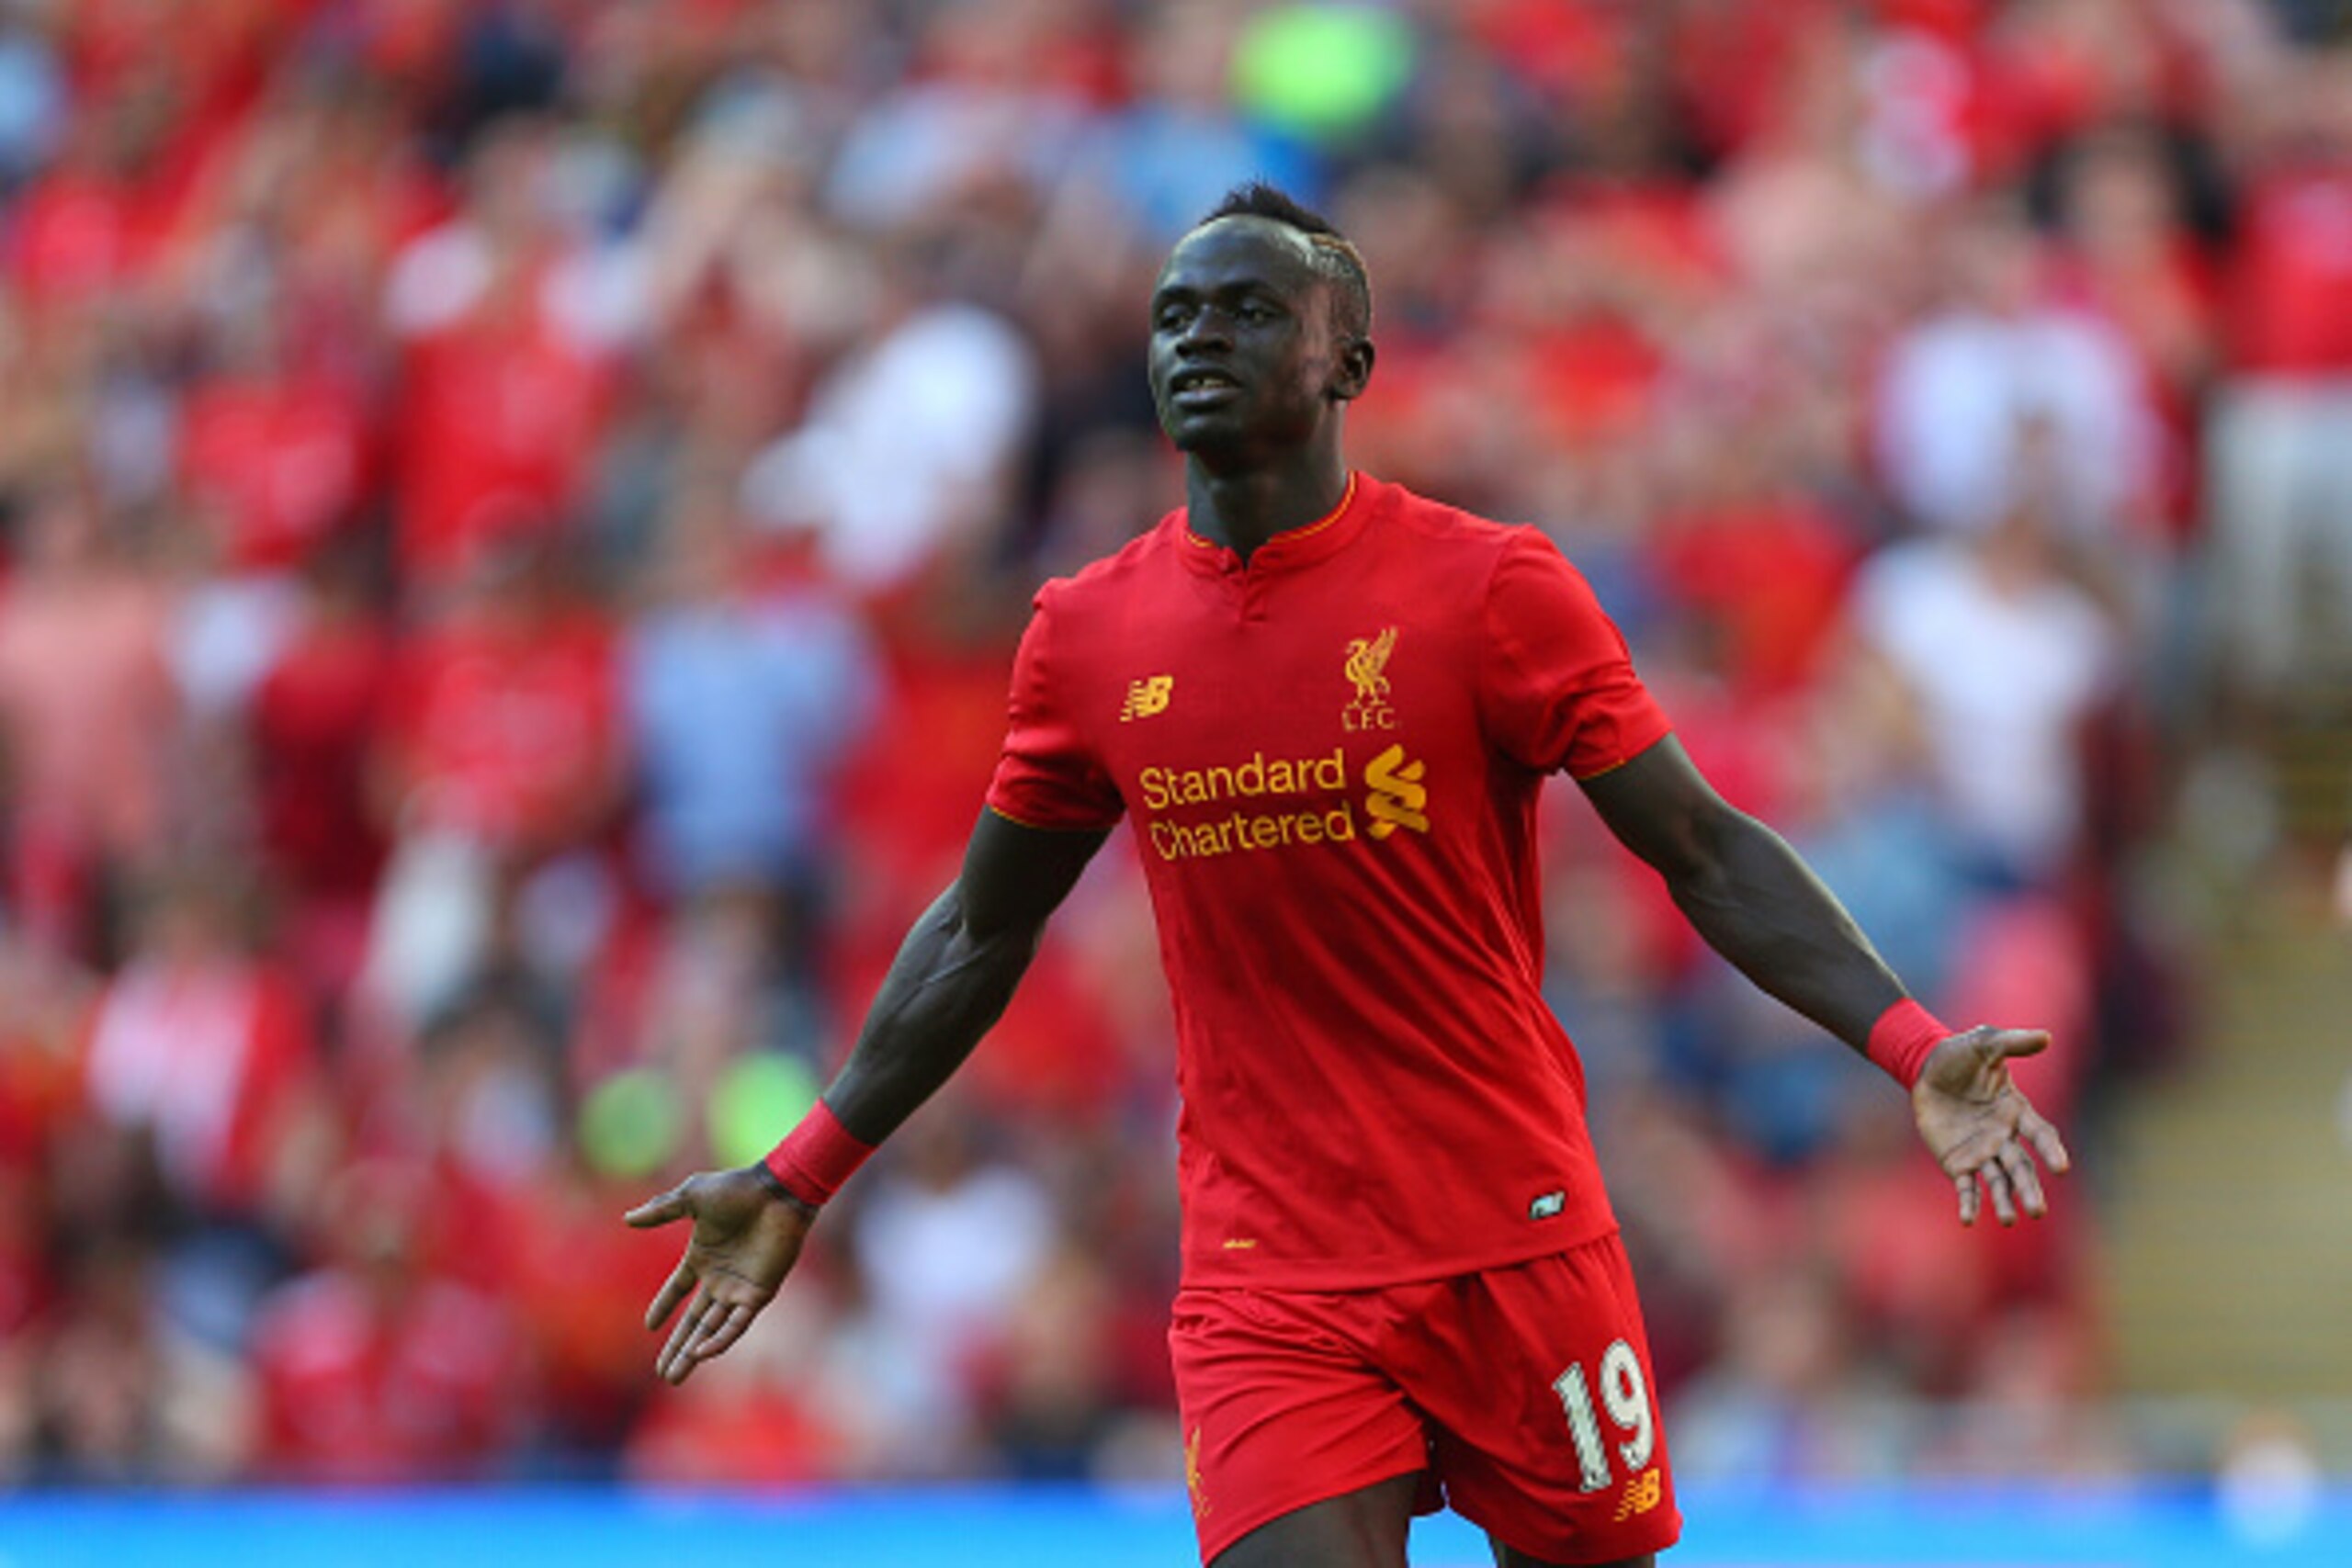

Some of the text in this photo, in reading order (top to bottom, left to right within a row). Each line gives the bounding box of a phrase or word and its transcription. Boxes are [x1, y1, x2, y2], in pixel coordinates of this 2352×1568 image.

[1139, 748, 1346, 810] Standard
[1150, 801, 1355, 861] Chartered
[1553, 1340, 1654, 1492] 19
